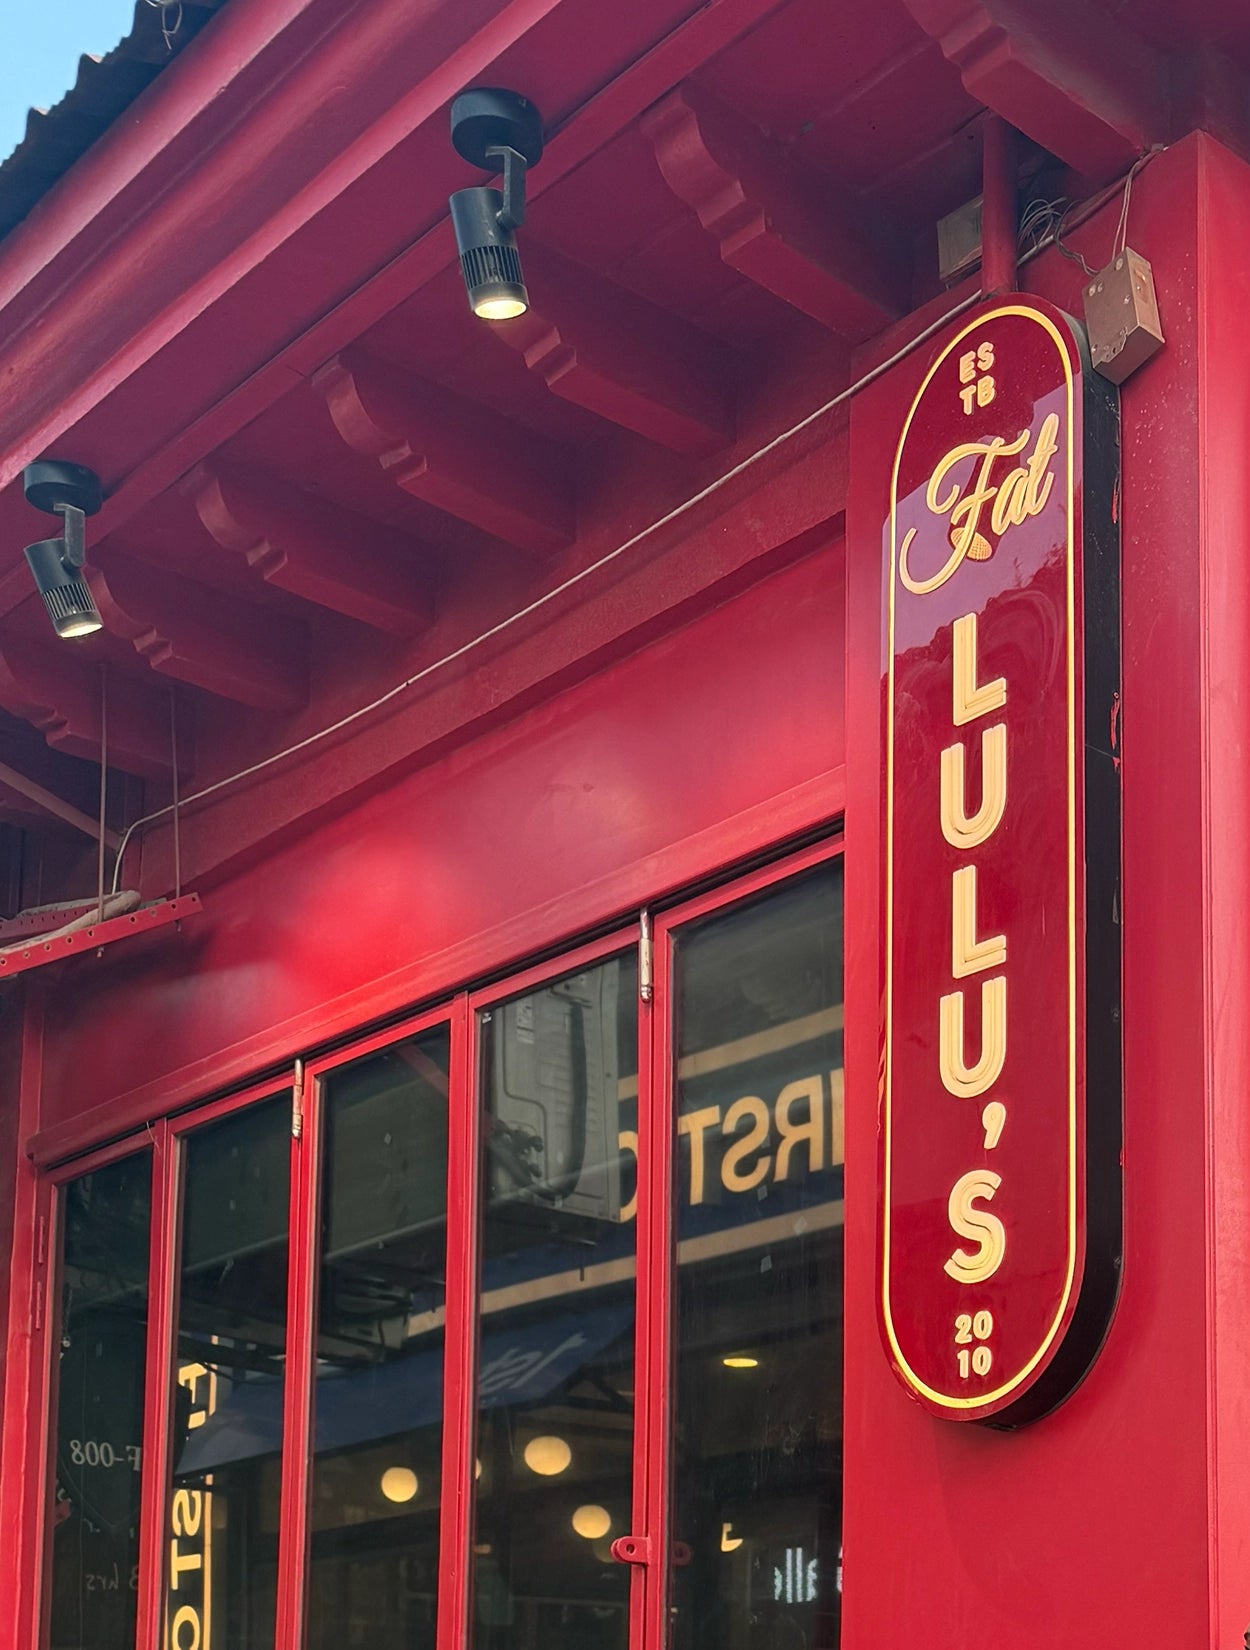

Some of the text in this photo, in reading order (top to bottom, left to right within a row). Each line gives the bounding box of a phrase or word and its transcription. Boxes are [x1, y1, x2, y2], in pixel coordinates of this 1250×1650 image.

[959, 341, 995, 384] ES
[959, 375, 996, 416] TB
[898, 412, 1060, 595] Fat
[938, 612, 1009, 1284] LULU'S
[954, 1309, 994, 1345] 20
[956, 1345, 993, 1379] 10
